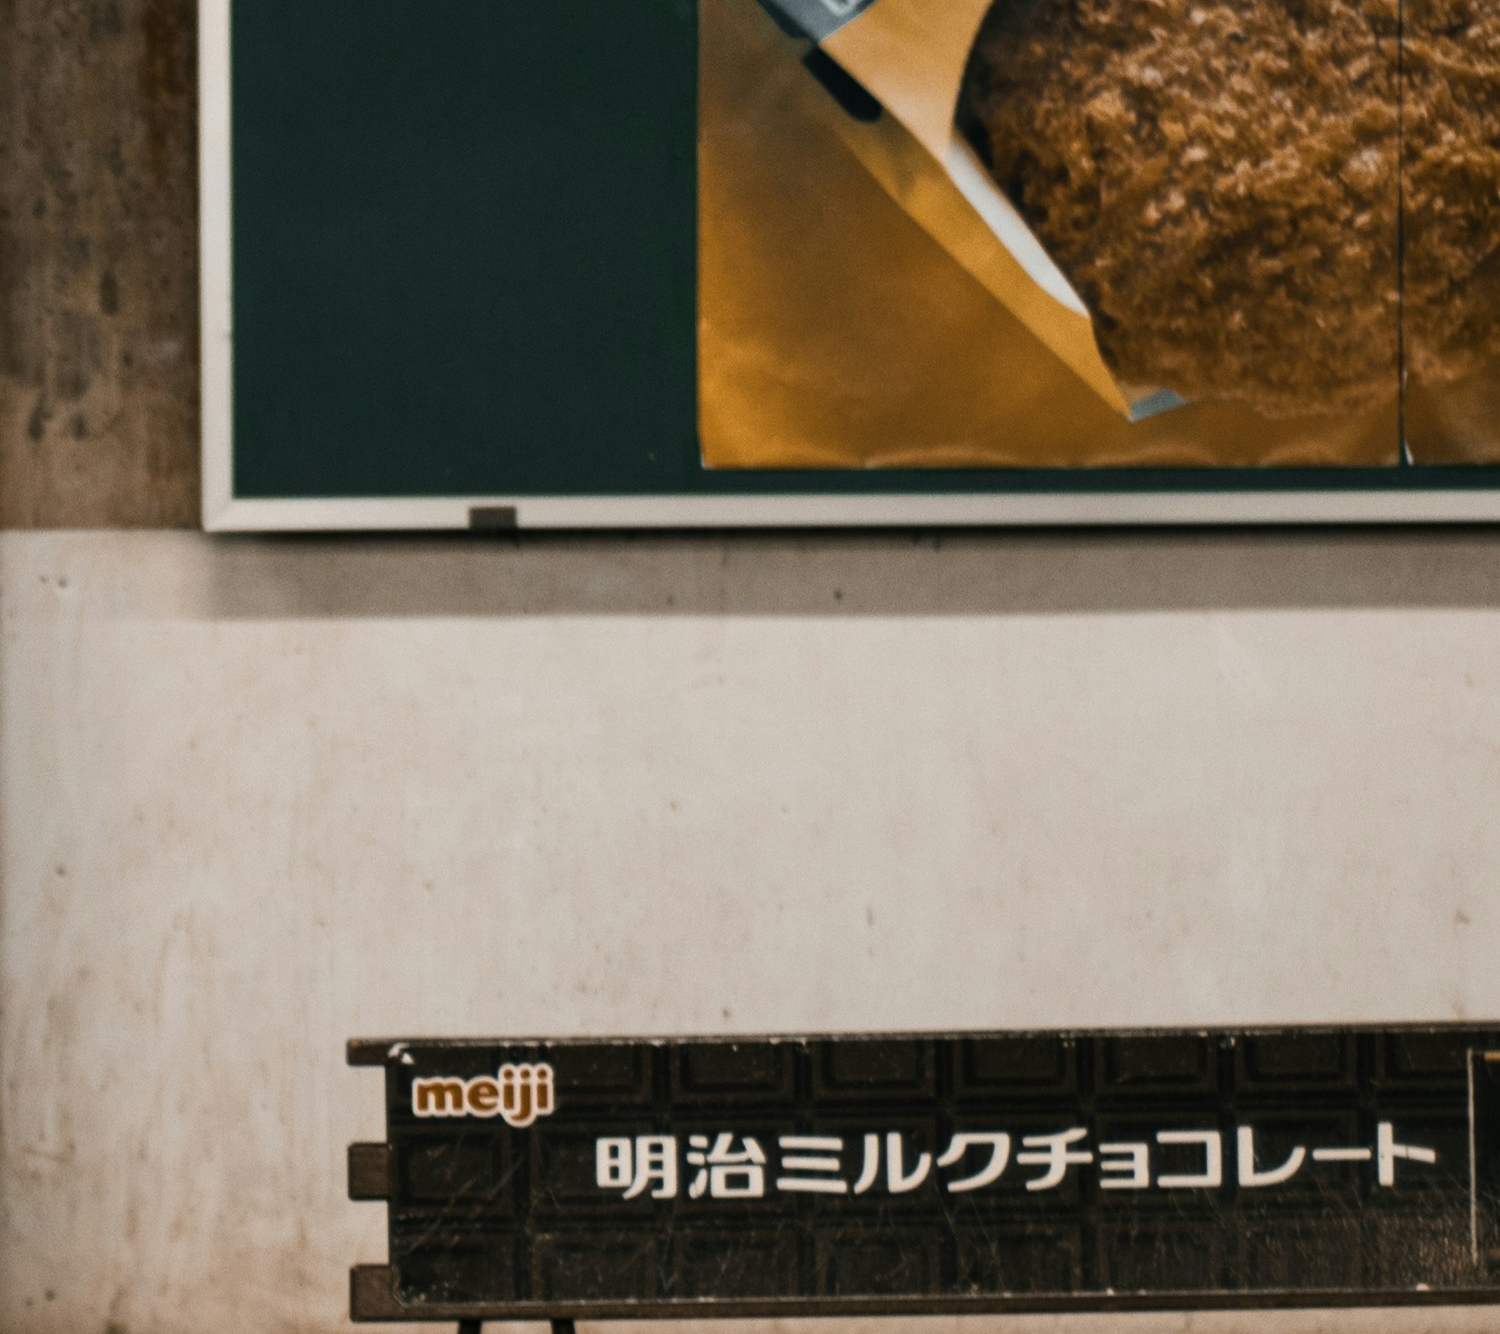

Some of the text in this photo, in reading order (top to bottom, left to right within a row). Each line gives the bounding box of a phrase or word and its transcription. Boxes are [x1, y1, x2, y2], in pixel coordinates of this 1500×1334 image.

[413, 1063, 554, 1126] meiji
[595, 1120, 1437, 1200] 明治ミルクチョコレート
